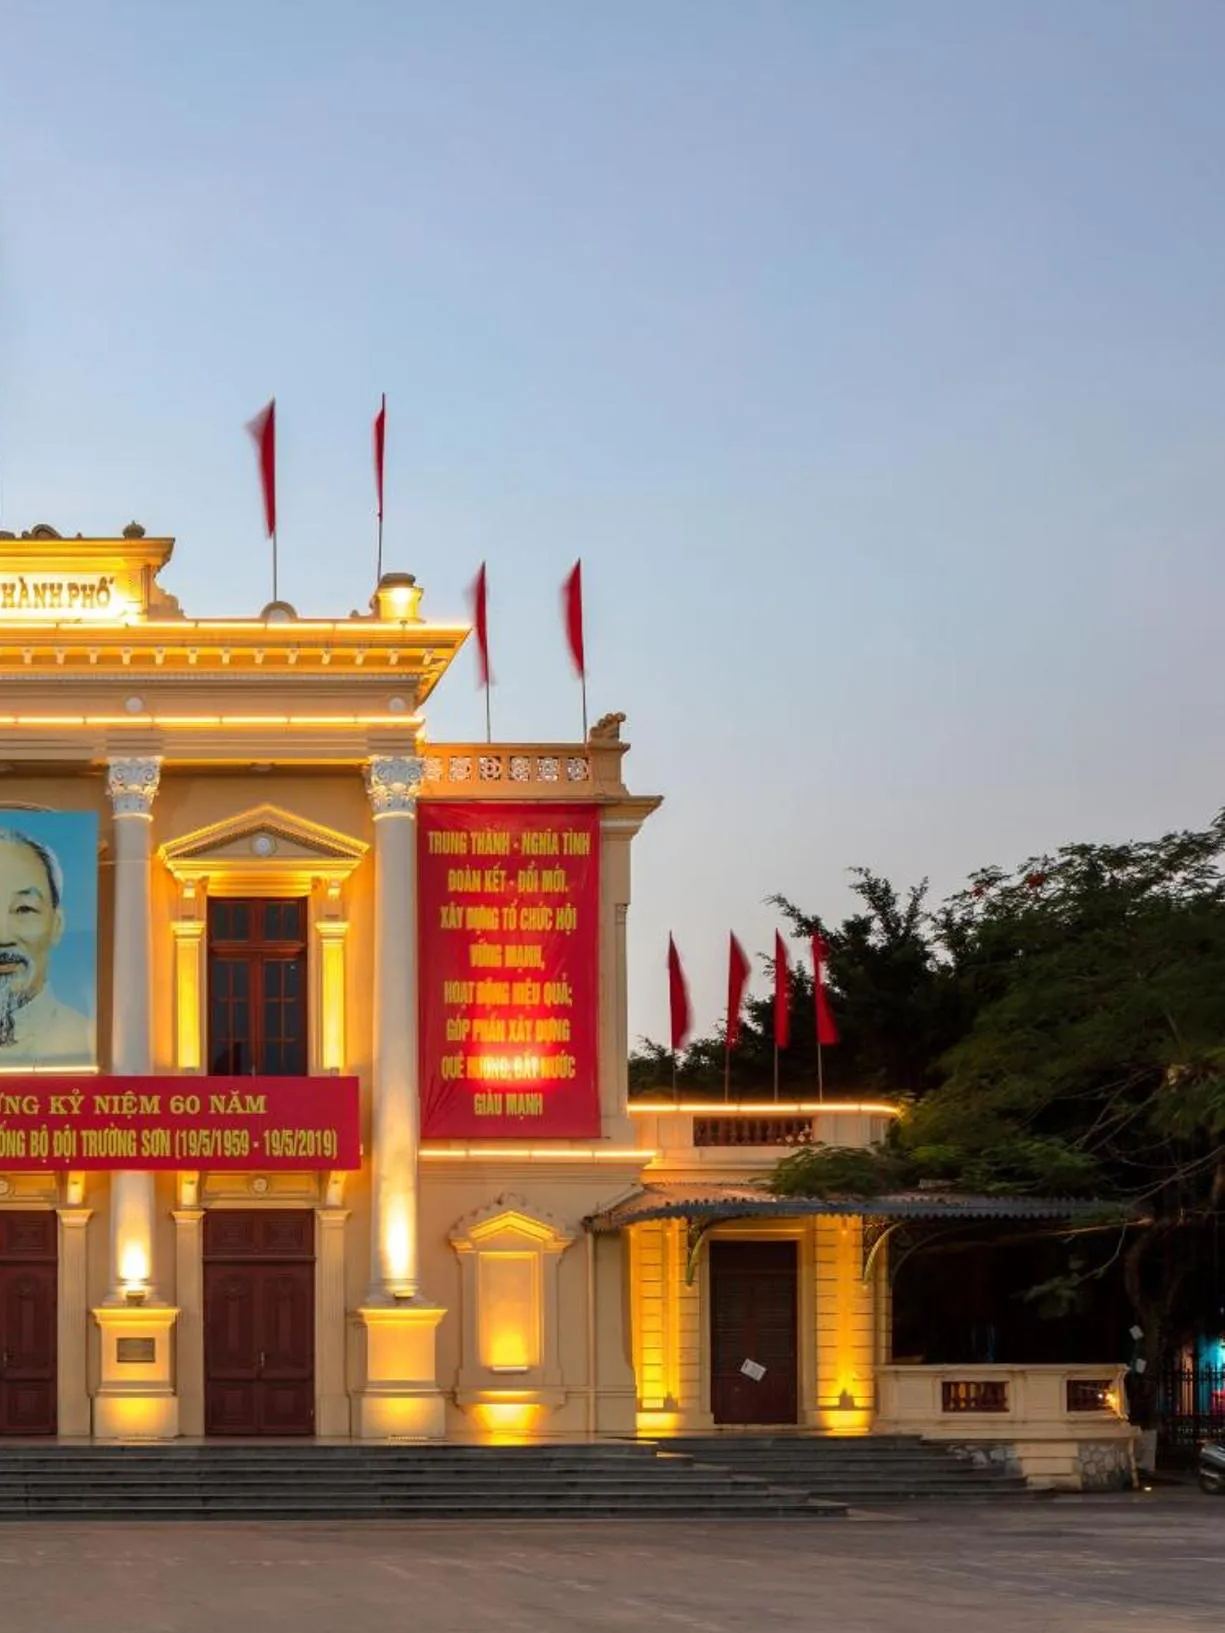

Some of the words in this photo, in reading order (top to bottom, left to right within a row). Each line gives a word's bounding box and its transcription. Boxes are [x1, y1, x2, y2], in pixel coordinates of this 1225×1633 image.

[67, 576, 115, 609] PHỐ
[428, 831, 467, 854] TRUNG
[471, 827, 510, 854] THÀNH
[521, 828, 559, 854] NGHĨA
[562, 828, 590, 854] TÌNH
[484, 861, 507, 892] KẾT
[556, 903, 577, 935] HỘI
[49, 1089, 85, 1115] KỶ
[93, 1090, 161, 1119] NIỆM
[170, 1096, 201, 1115] 60
[209, 1090, 267, 1115] NĂM
[30, 1124, 49, 1163] BỘ
[53, 1124, 76, 1163] ĐỘI
[80, 1123, 140, 1157] TRƯỜNG
[142, 1130, 171, 1156] SƠN
